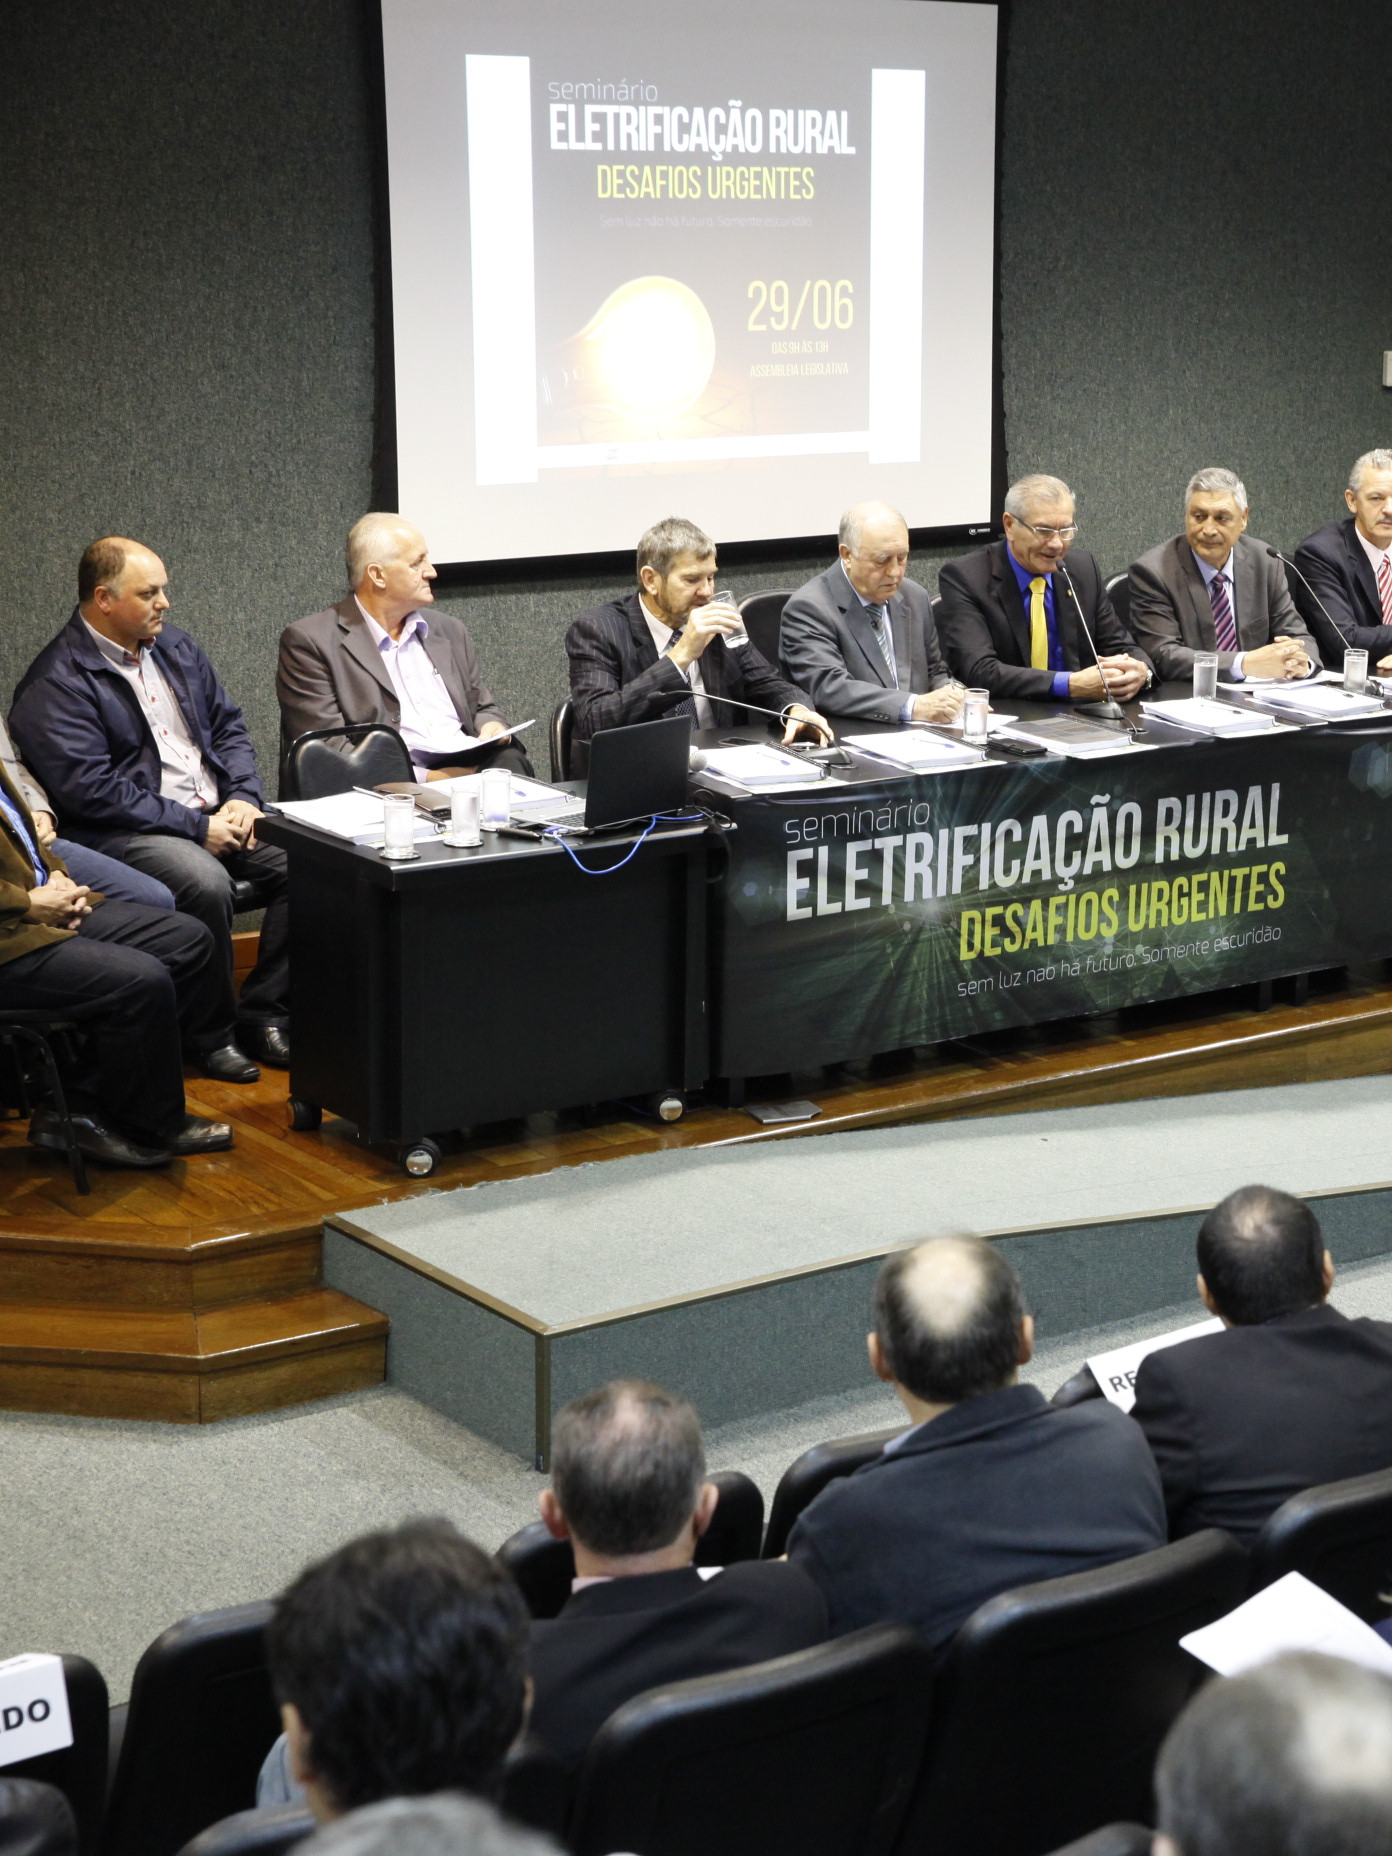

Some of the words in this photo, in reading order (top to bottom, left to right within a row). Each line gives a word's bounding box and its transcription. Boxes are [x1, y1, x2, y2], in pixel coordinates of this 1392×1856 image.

[548, 78, 658, 103] seminário
[549, 99, 763, 161] ELETRIFICAÇÃO
[769, 108, 856, 155] RURAL
[596, 164, 702, 199] DESAFIOS
[707, 166, 816, 200] URGENTES
[746, 279, 855, 331] 29/06
[784, 799, 931, 845] seminário
[785, 793, 1142, 922] ELETRIFICAÇÃO
[1154, 782, 1289, 866] RURAL
[959, 886, 1119, 961] DESAFIOS
[1128, 861, 1286, 933] URGENTES
[957, 977, 994, 998] sem
[999, 969, 1022, 990] luz
[1060, 957, 1081, 978] há
[1086, 953, 1137, 975] futuro.
[1142, 940, 1209, 966] Somente
[1213, 924, 1282, 952] escuridão
[0, 1698, 51, 1732] DO
